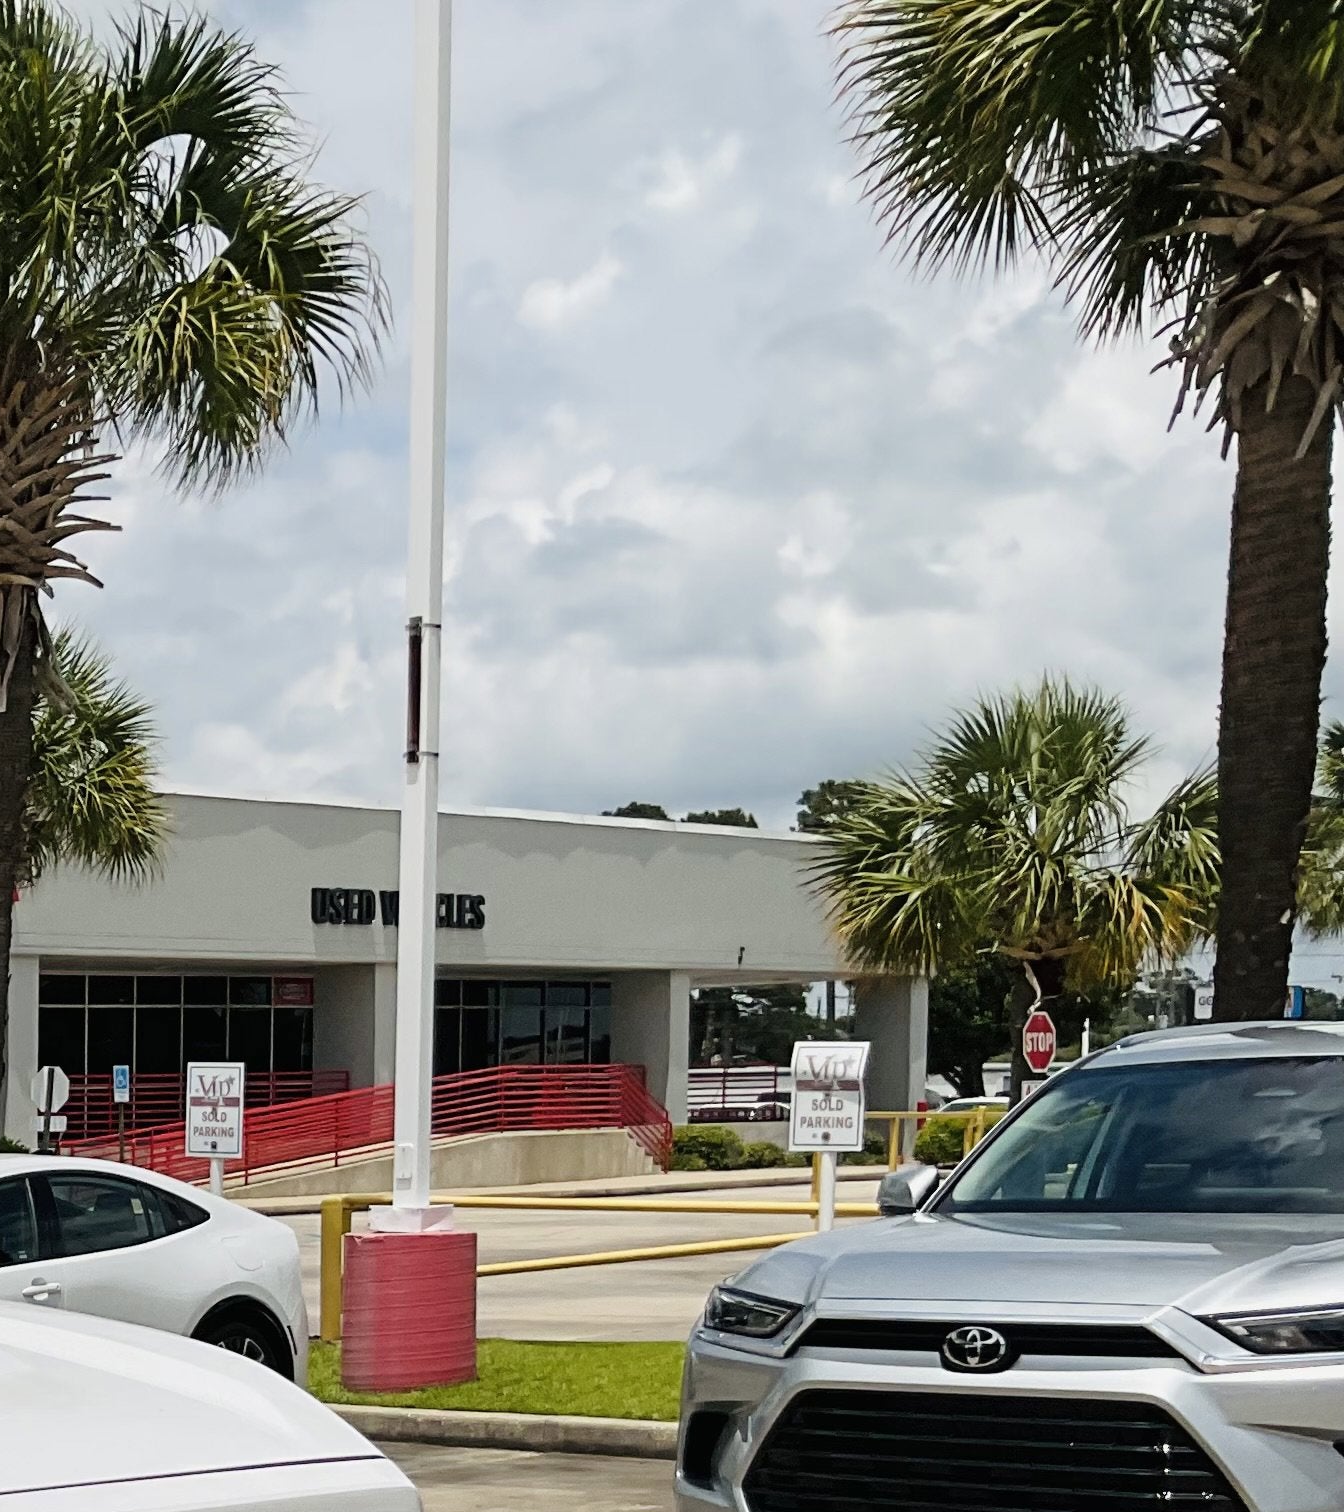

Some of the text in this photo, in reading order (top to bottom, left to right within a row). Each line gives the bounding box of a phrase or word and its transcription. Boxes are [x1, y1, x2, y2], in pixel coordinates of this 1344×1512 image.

[311, 887, 485, 930] USED VCLES
[1026, 1032, 1052, 1053] STOP
[811, 1099, 844, 1112] SOLD
[201, 1111, 227, 1122] SOLD
[800, 1116, 853, 1128] PARKING
[193, 1126, 234, 1138] PARKING
